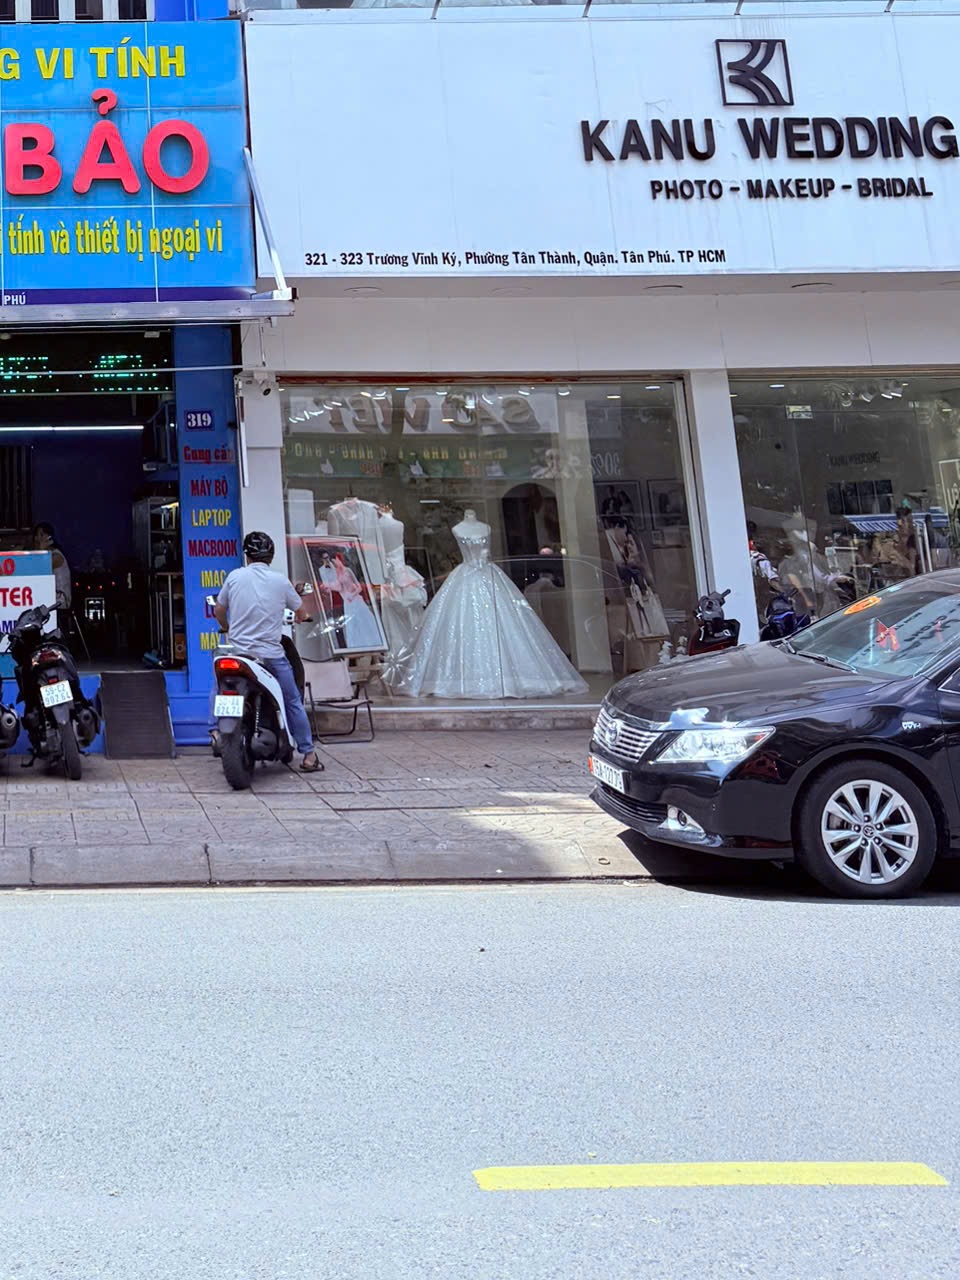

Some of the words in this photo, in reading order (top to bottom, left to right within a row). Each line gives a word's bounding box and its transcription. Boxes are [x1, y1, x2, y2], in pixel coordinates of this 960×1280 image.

[35, 48, 74, 79] VI
[90, 37, 186, 78] TÍNH
[5, 88, 210, 196] BẢO
[581, 119, 715, 162] KANU
[737, 115, 960, 160] WEDDING
[651, 180, 723, 200] PHOTO
[747, 179, 836, 199] MAKEUP
[857, 177, 934, 198] BRIDAL
[8, 215, 45, 256] tính
[51, 222, 70, 255] và
[75, 215, 120, 254] thiết
[126, 219, 143, 263] bị
[149, 218, 201, 263] ngoại
[206, 221, 223, 252] vi
[304, 252, 328, 266] 321
[340, 252, 364, 266] 323
[366, 252, 409, 267] Trương
[411, 252, 439, 265] Vĩnh
[442, 251, 462, 267] Ký,
[465, 251, 510, 267] Phường
[512, 251, 536, 265] Tân
[539, 251, 581, 267] Thành,
[583, 251, 619, 267] Quận.
[621, 250, 645, 264] Tân
[648, 250, 676, 264] Phú.
[678, 250, 695, 264] TP
[697, 249, 727, 263] HCM
[3, 291, 27, 306] PHÚ
[187, 412, 212, 427] 319
[190, 475, 211, 496] MÁY
[214, 475, 228, 499] BỘ
[192, 509, 232, 527] LAPTOP
[189, 539, 238, 557] MACBOOK
